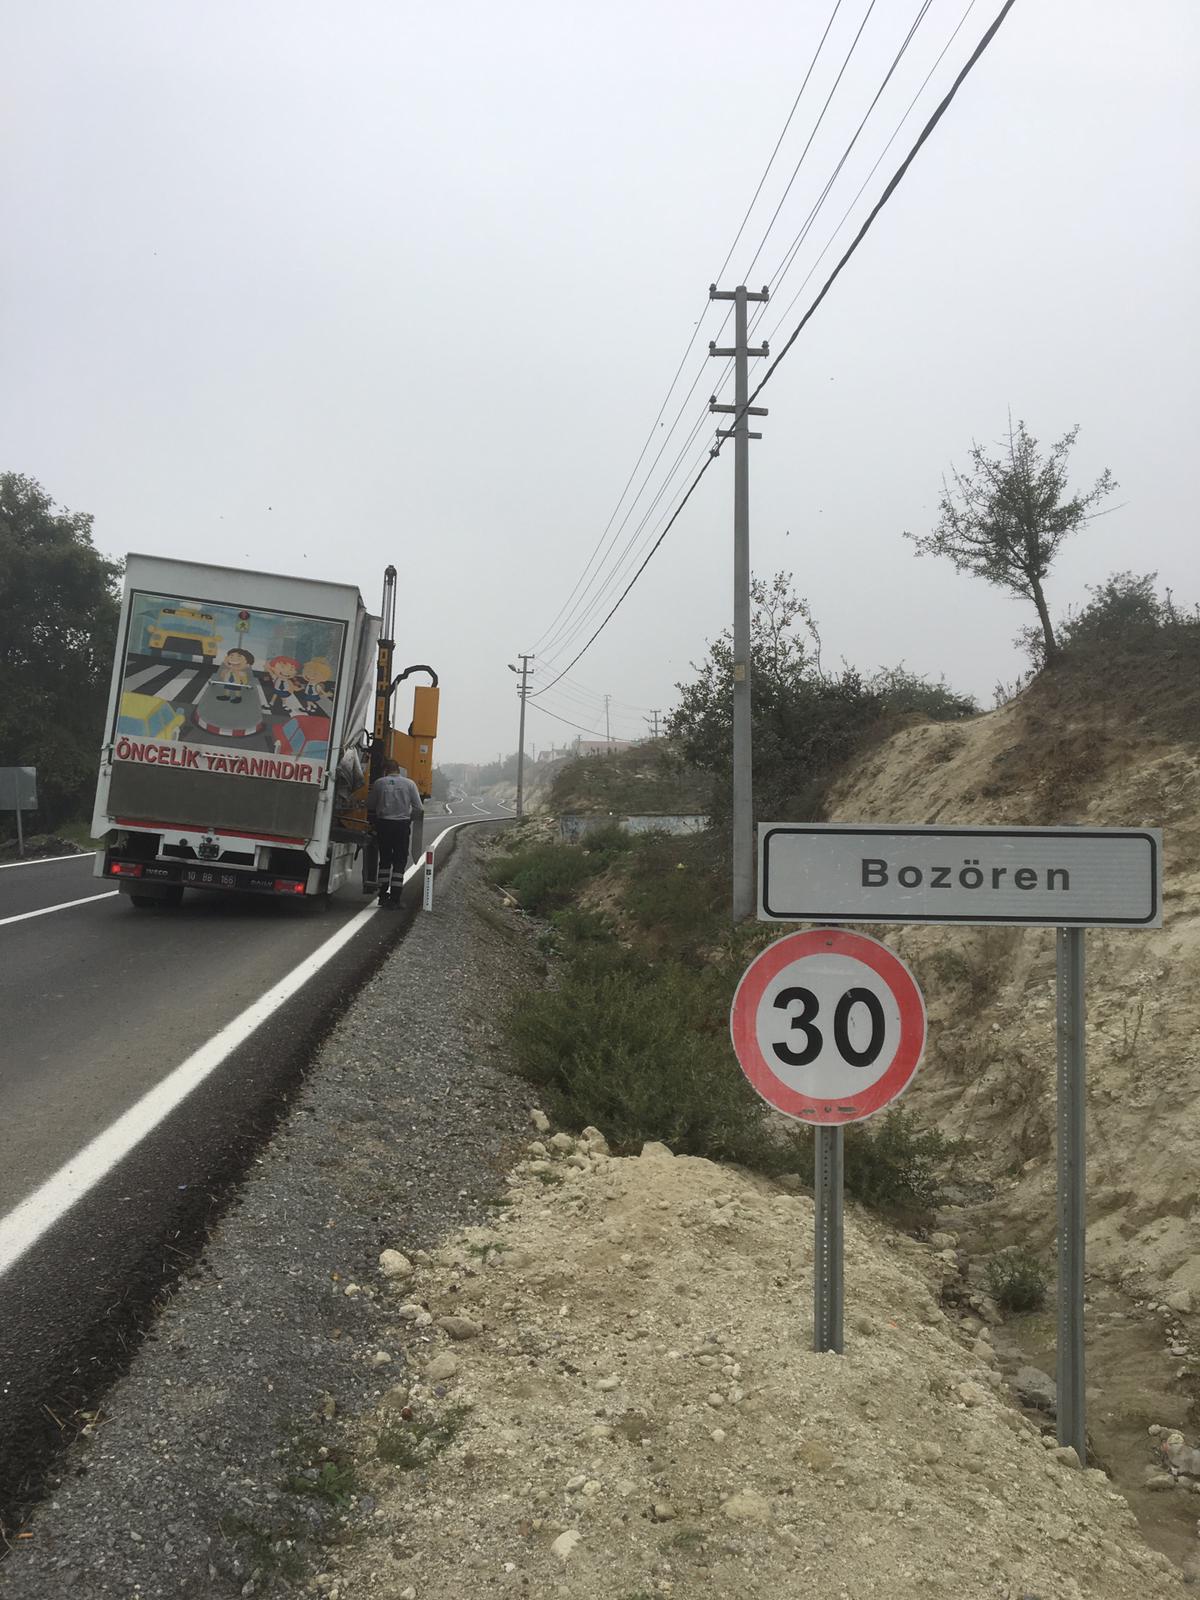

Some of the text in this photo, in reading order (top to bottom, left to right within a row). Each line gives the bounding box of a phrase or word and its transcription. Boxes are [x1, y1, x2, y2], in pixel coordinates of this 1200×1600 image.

[116, 737, 200, 769] ÖNCELİK
[204, 752, 313, 783] YAYANINDIR
[861, 858, 1071, 891] Bozören
[771, 986, 886, 1068] 30
